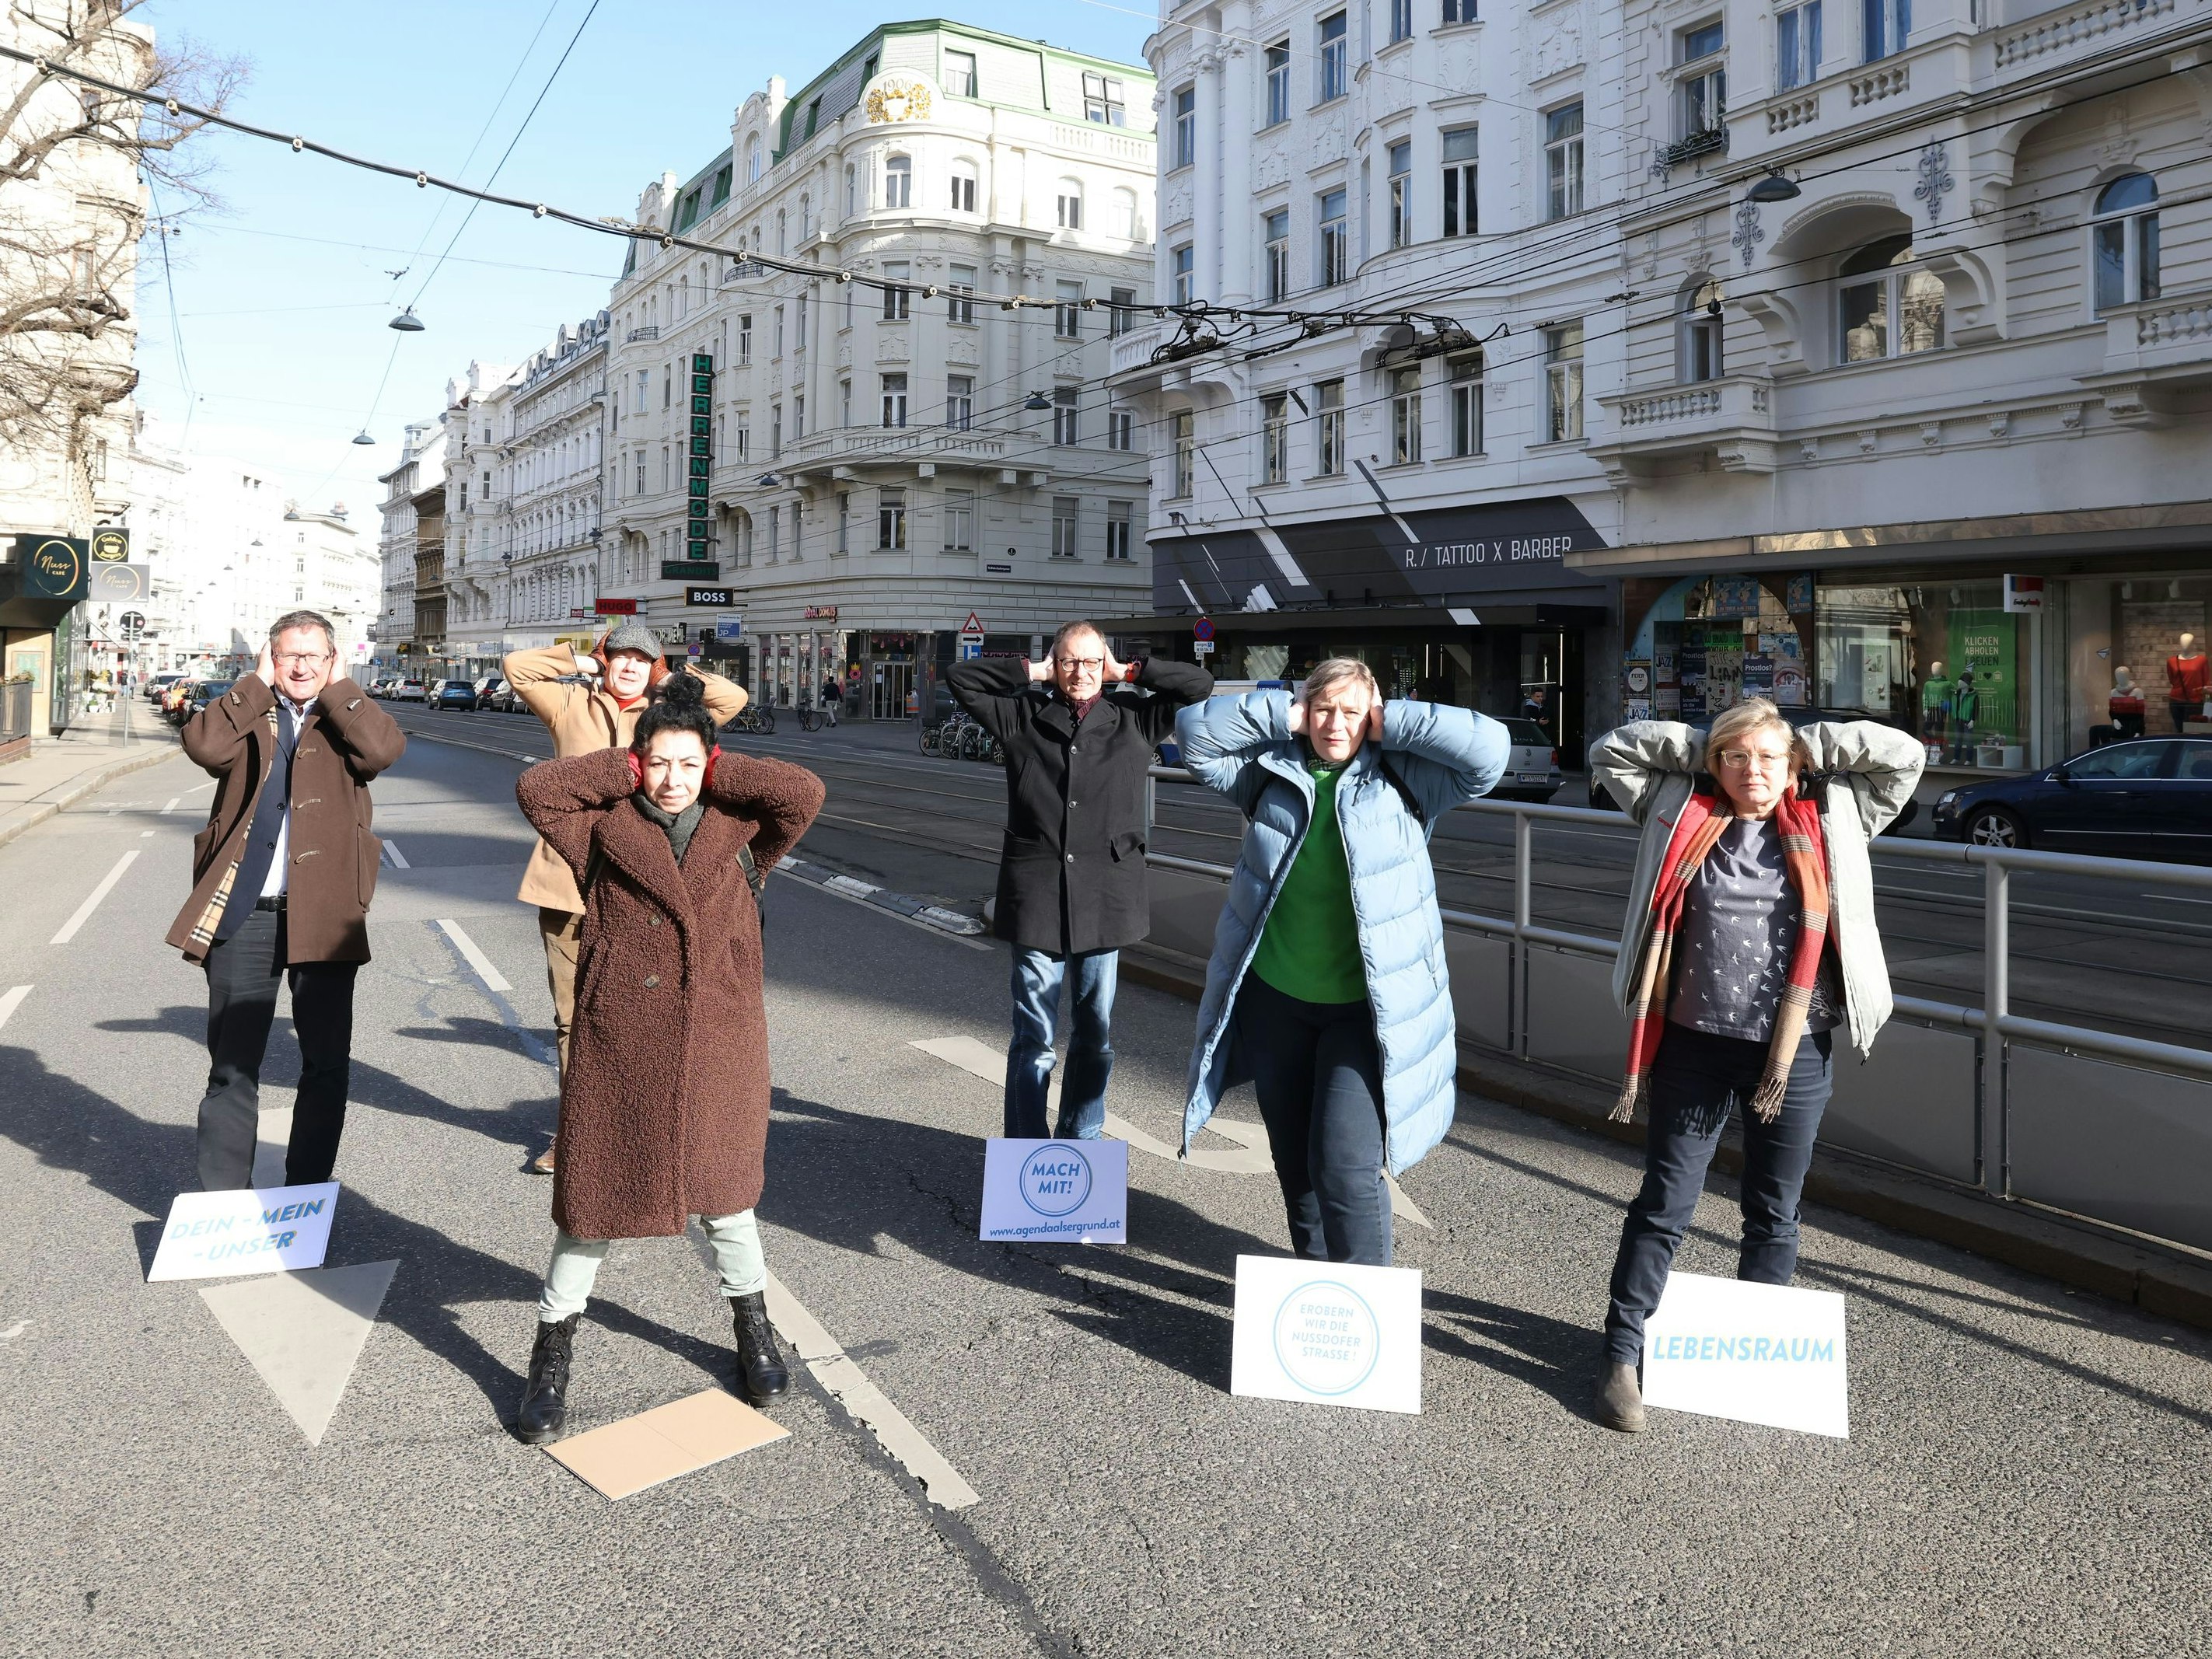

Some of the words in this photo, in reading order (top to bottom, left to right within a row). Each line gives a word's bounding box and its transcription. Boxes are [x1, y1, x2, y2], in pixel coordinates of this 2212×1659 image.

[883, 78, 912, 91] 1906
[690, 355, 710, 557] HERRENMODE
[101, 536, 123, 544] Golden
[1435, 543, 1485, 565] TATTOO
[1494, 542, 1502, 561] X
[1511, 536, 1571, 561] BARBER
[41, 555, 72, 574] Nuss
[694, 592, 725, 602] BOSS
[599, 602, 632, 611] HUGO
[804, 607, 818, 618] ROYAL
[819, 606, 836, 617] DONUTS
[1965, 637, 1999, 645] KLICKEN
[1965, 647, 1999, 655] ABHOLEN
[1656, 656, 1672, 668] JAZZ
[1629, 708, 1648, 720] JAZZ
[1032, 1163, 1080, 1176] MACH
[1038, 1181, 1073, 1194] MIT!
[169, 1215, 236, 1240] DEIN
[256, 1198, 327, 1226] MEIN
[990, 1218, 1120, 1238] www.agendaalsergrund.at
[208, 1230, 298, 1261] UNSER
[1300, 1304, 1354, 1318] EROBERN
[1305, 1318, 1326, 1329] WIR
[1330, 1321, 1348, 1332] DIE
[1292, 1332, 1361, 1347] NUSSDOFER
[1302, 1346, 1349, 1360] STRASSE
[1653, 1336, 1834, 1362] LEBENSRAUM
